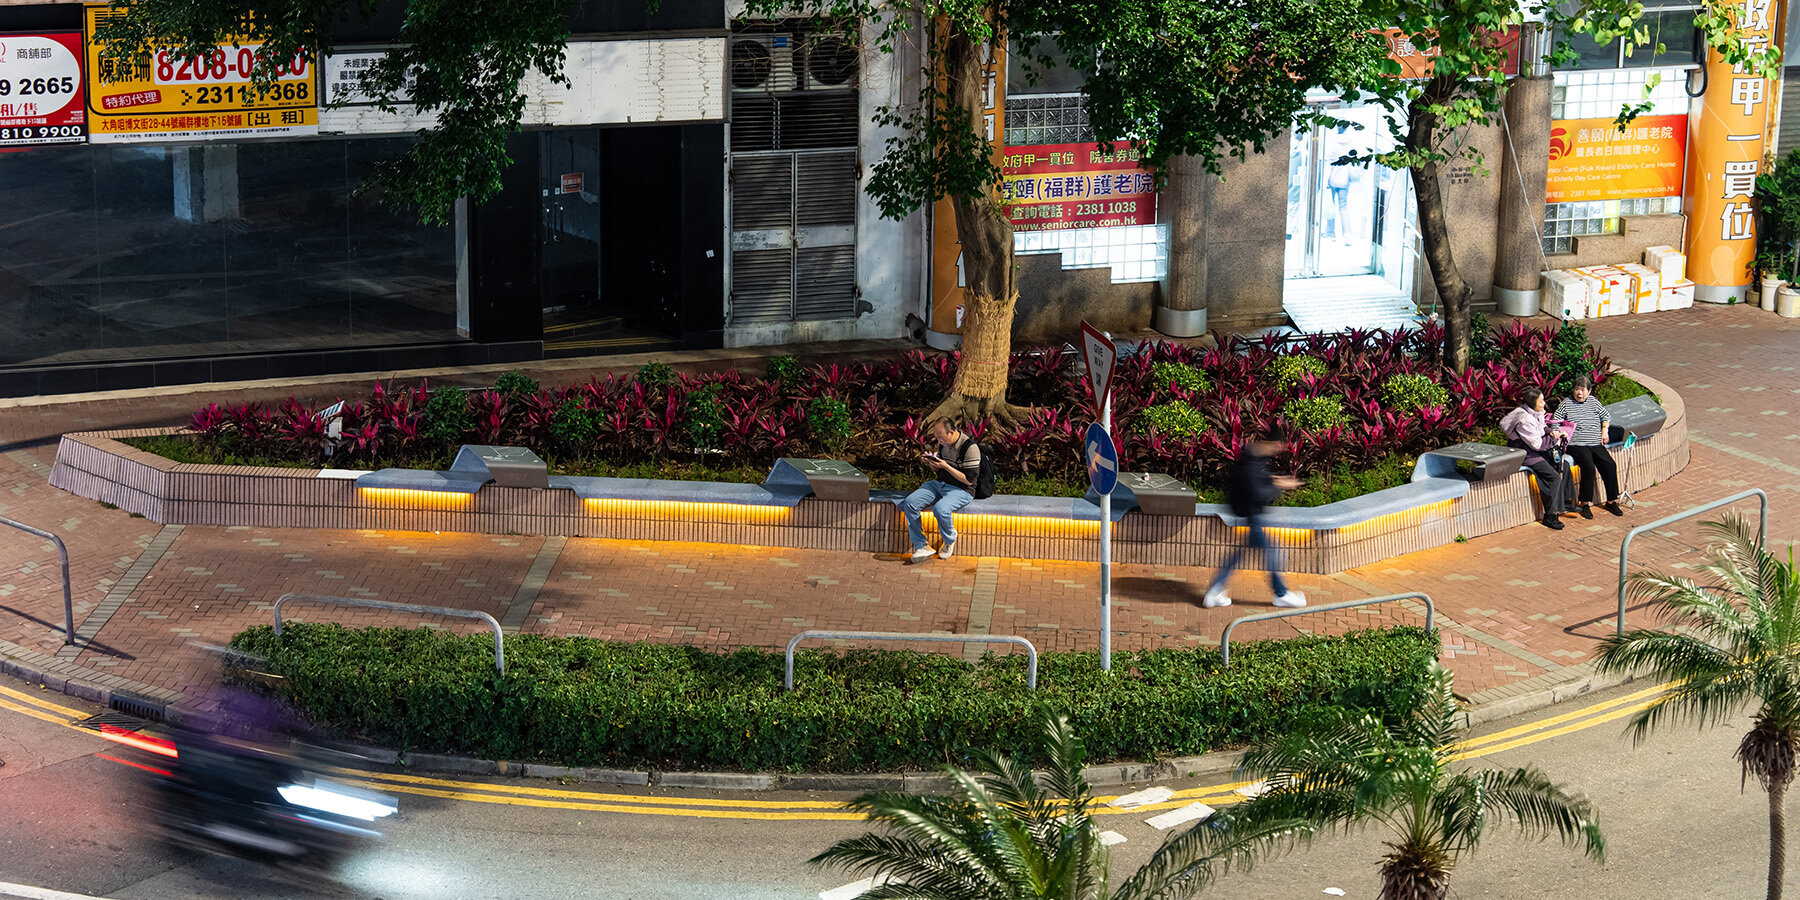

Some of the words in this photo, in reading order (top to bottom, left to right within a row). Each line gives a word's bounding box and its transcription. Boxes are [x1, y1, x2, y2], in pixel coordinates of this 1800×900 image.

[19, 77, 73, 95] 2665
[105, 91, 158, 108] 特約代理
[39, 126, 81, 138] 9900
[1076, 204, 1105, 216] 2381
[1108, 201, 1137, 213] 1038
